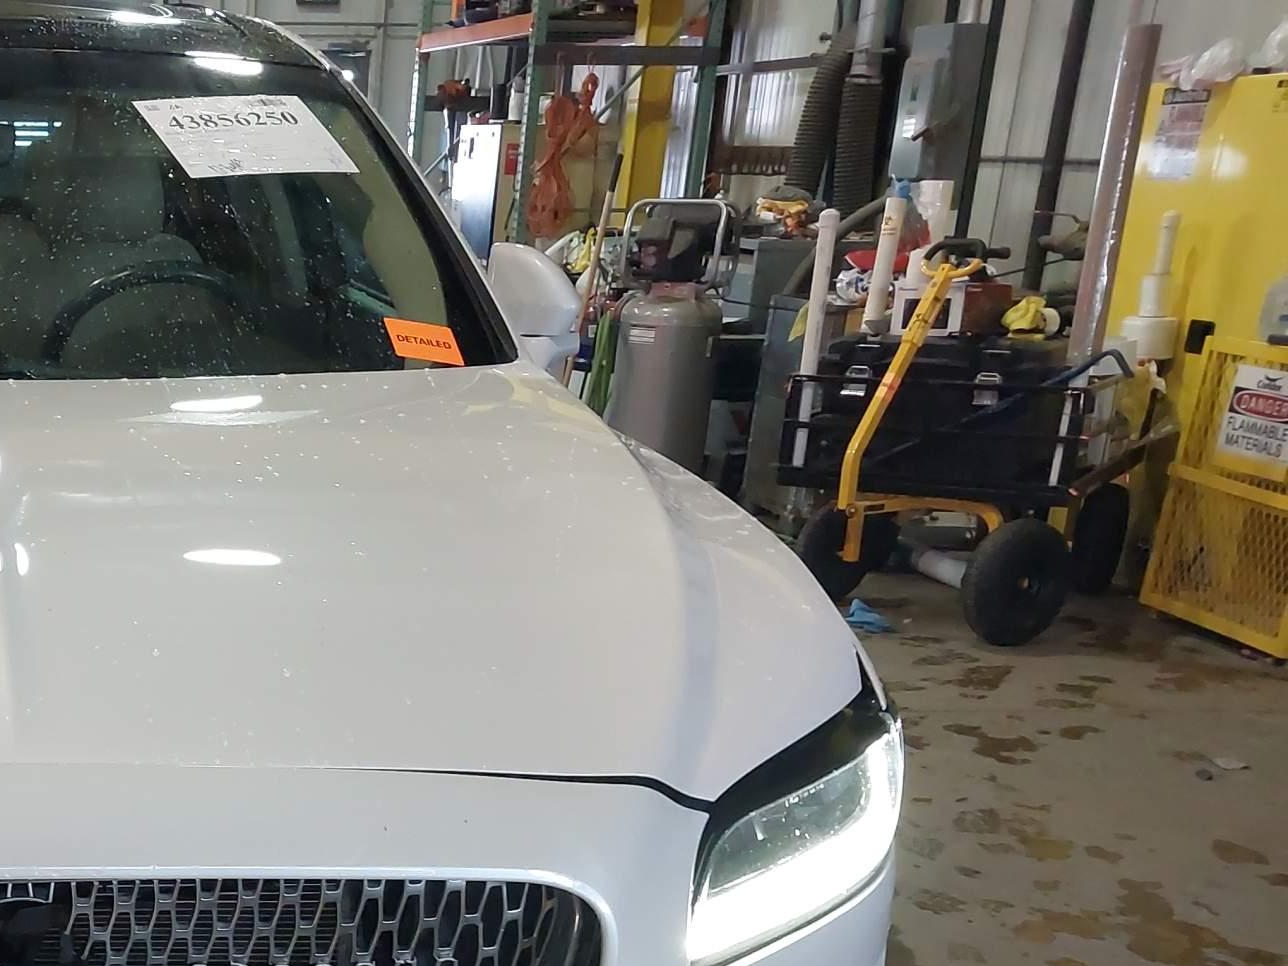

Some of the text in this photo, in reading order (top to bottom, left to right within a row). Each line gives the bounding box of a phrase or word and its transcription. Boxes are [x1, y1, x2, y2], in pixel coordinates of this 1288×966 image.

[168, 110, 299, 130] 43856250
[396, 334, 452, 350] DETAILED
[1227, 416, 1288, 442] FLAMMABLE
[1224, 432, 1283, 458] MATERIALS
